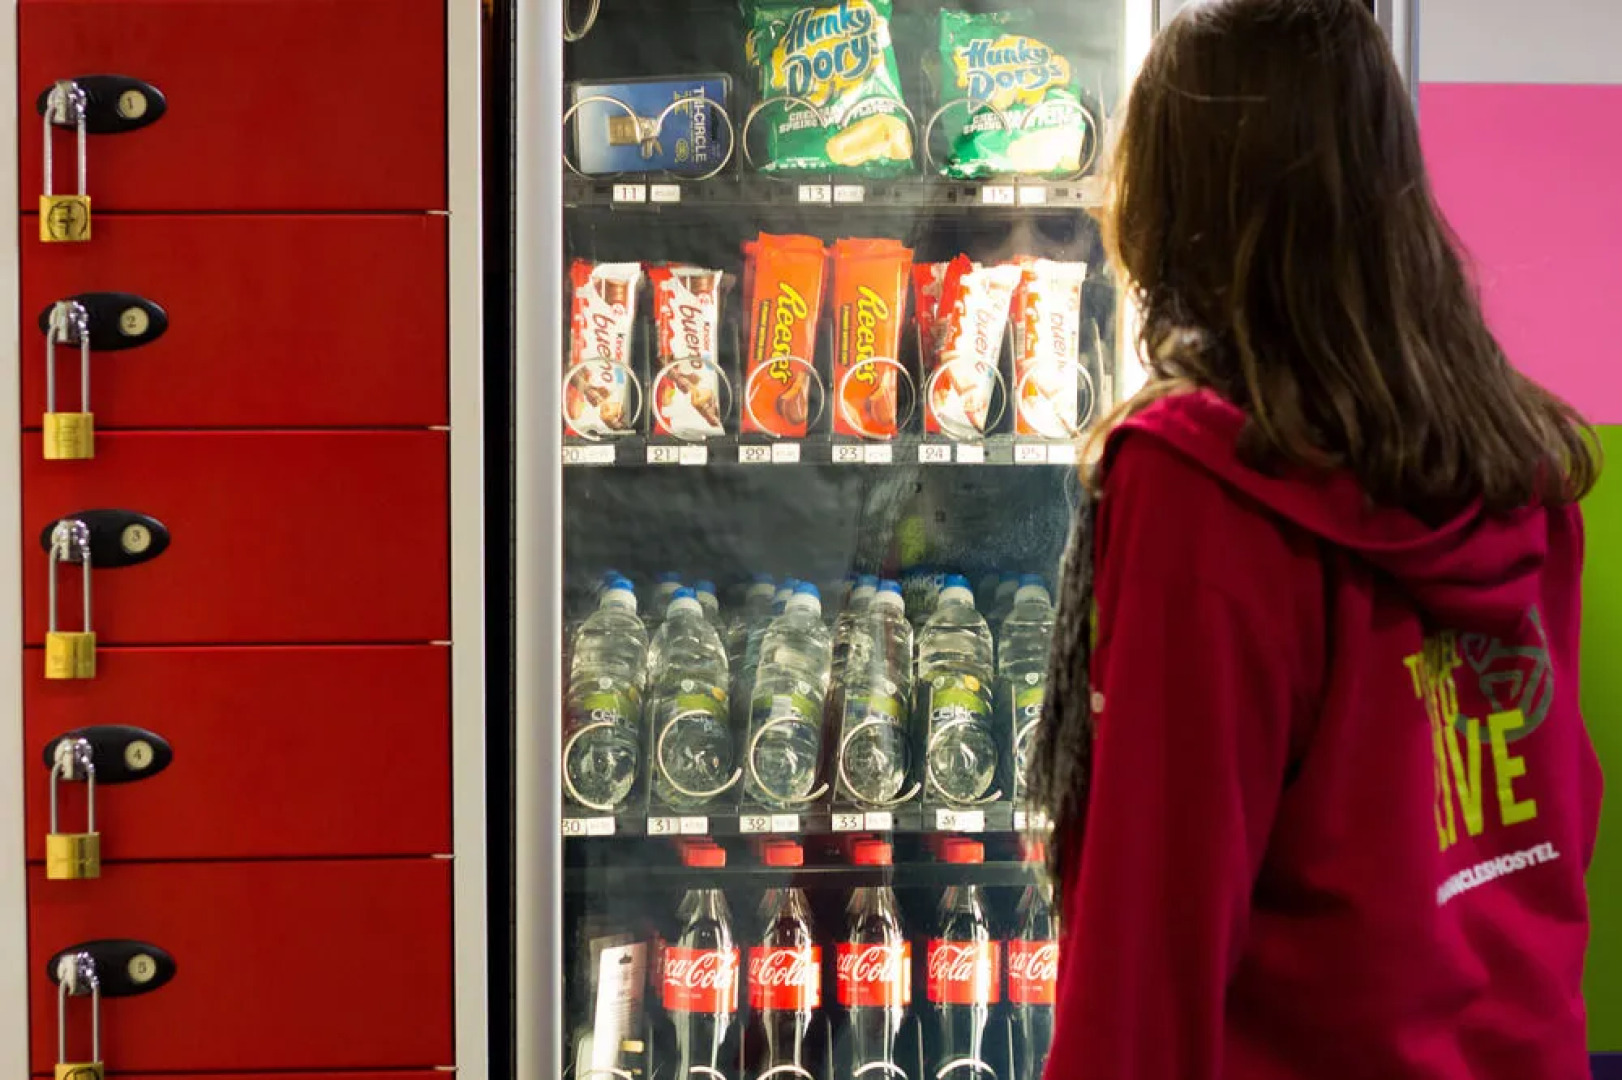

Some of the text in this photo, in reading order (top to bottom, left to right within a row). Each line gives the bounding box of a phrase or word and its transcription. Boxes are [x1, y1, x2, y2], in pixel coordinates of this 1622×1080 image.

[785, 1, 872, 55] Hunky
[962, 38, 1048, 68] Hunky
[694, 86, 707, 163] TI-CIRCLE
[622, 188, 636, 199] 11
[808, 187, 824, 199] 13
[991, 188, 1008, 200] 15
[127, 315, 137, 328] 2
[679, 304, 704, 370] bueno
[769, 281, 807, 384] Reese's
[592, 313, 616, 383] bueno
[653, 448, 671, 461] 21
[745, 447, 765, 460] 22
[839, 447, 857, 460] 23
[132, 529, 141, 542] 3
[133, 748, 142, 760] 4
[655, 821, 671, 833] 31
[749, 818, 766, 831] 32
[841, 818, 858, 830] 33
[137, 961, 147, 974] 5
